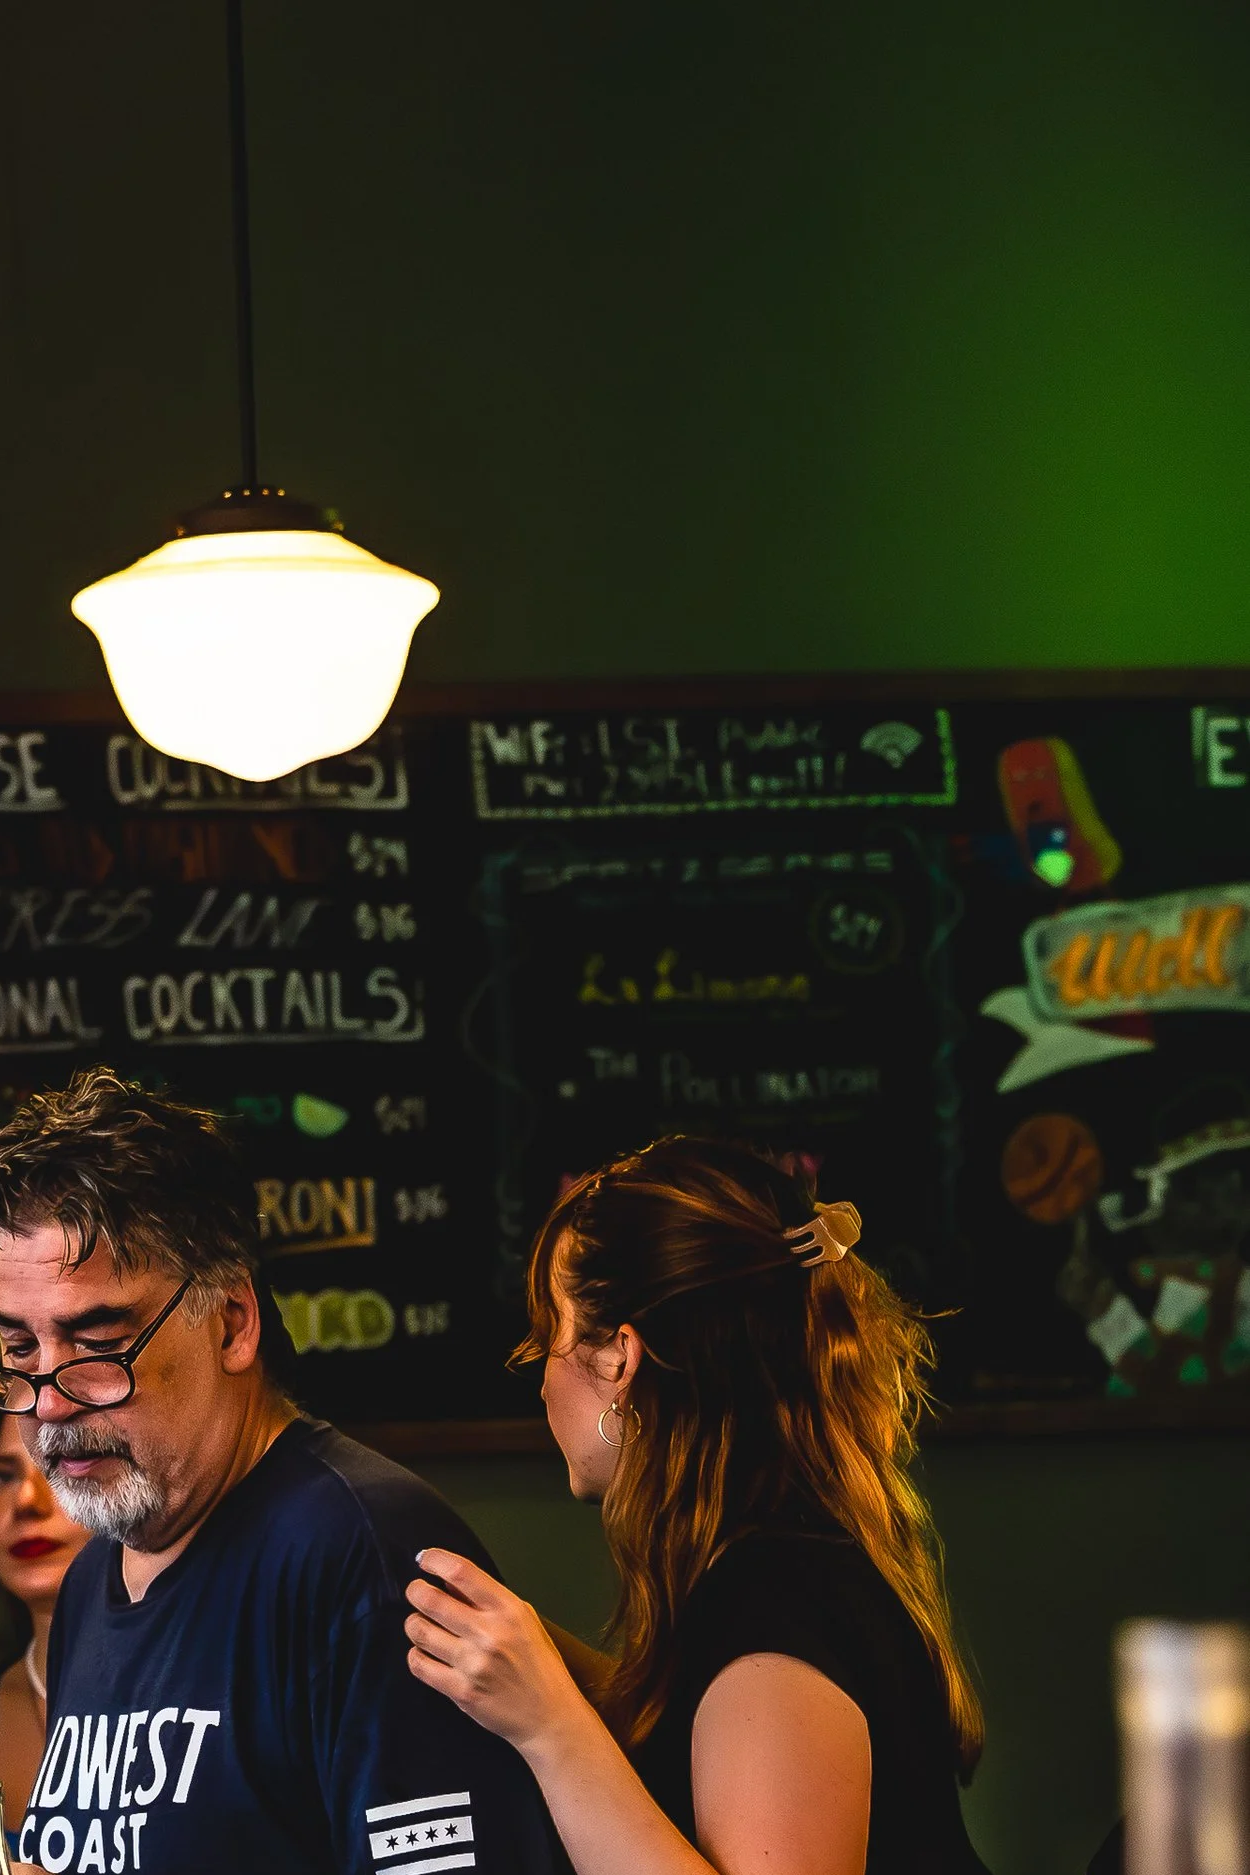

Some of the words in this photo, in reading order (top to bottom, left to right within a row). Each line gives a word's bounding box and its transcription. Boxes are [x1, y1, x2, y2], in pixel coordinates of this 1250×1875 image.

[108, 734, 386, 804] COCLS
[123, 967, 410, 1041] COCKTAILS
[28, 1707, 221, 1810] IDWEST
[19, 1812, 148, 1875] COAST
